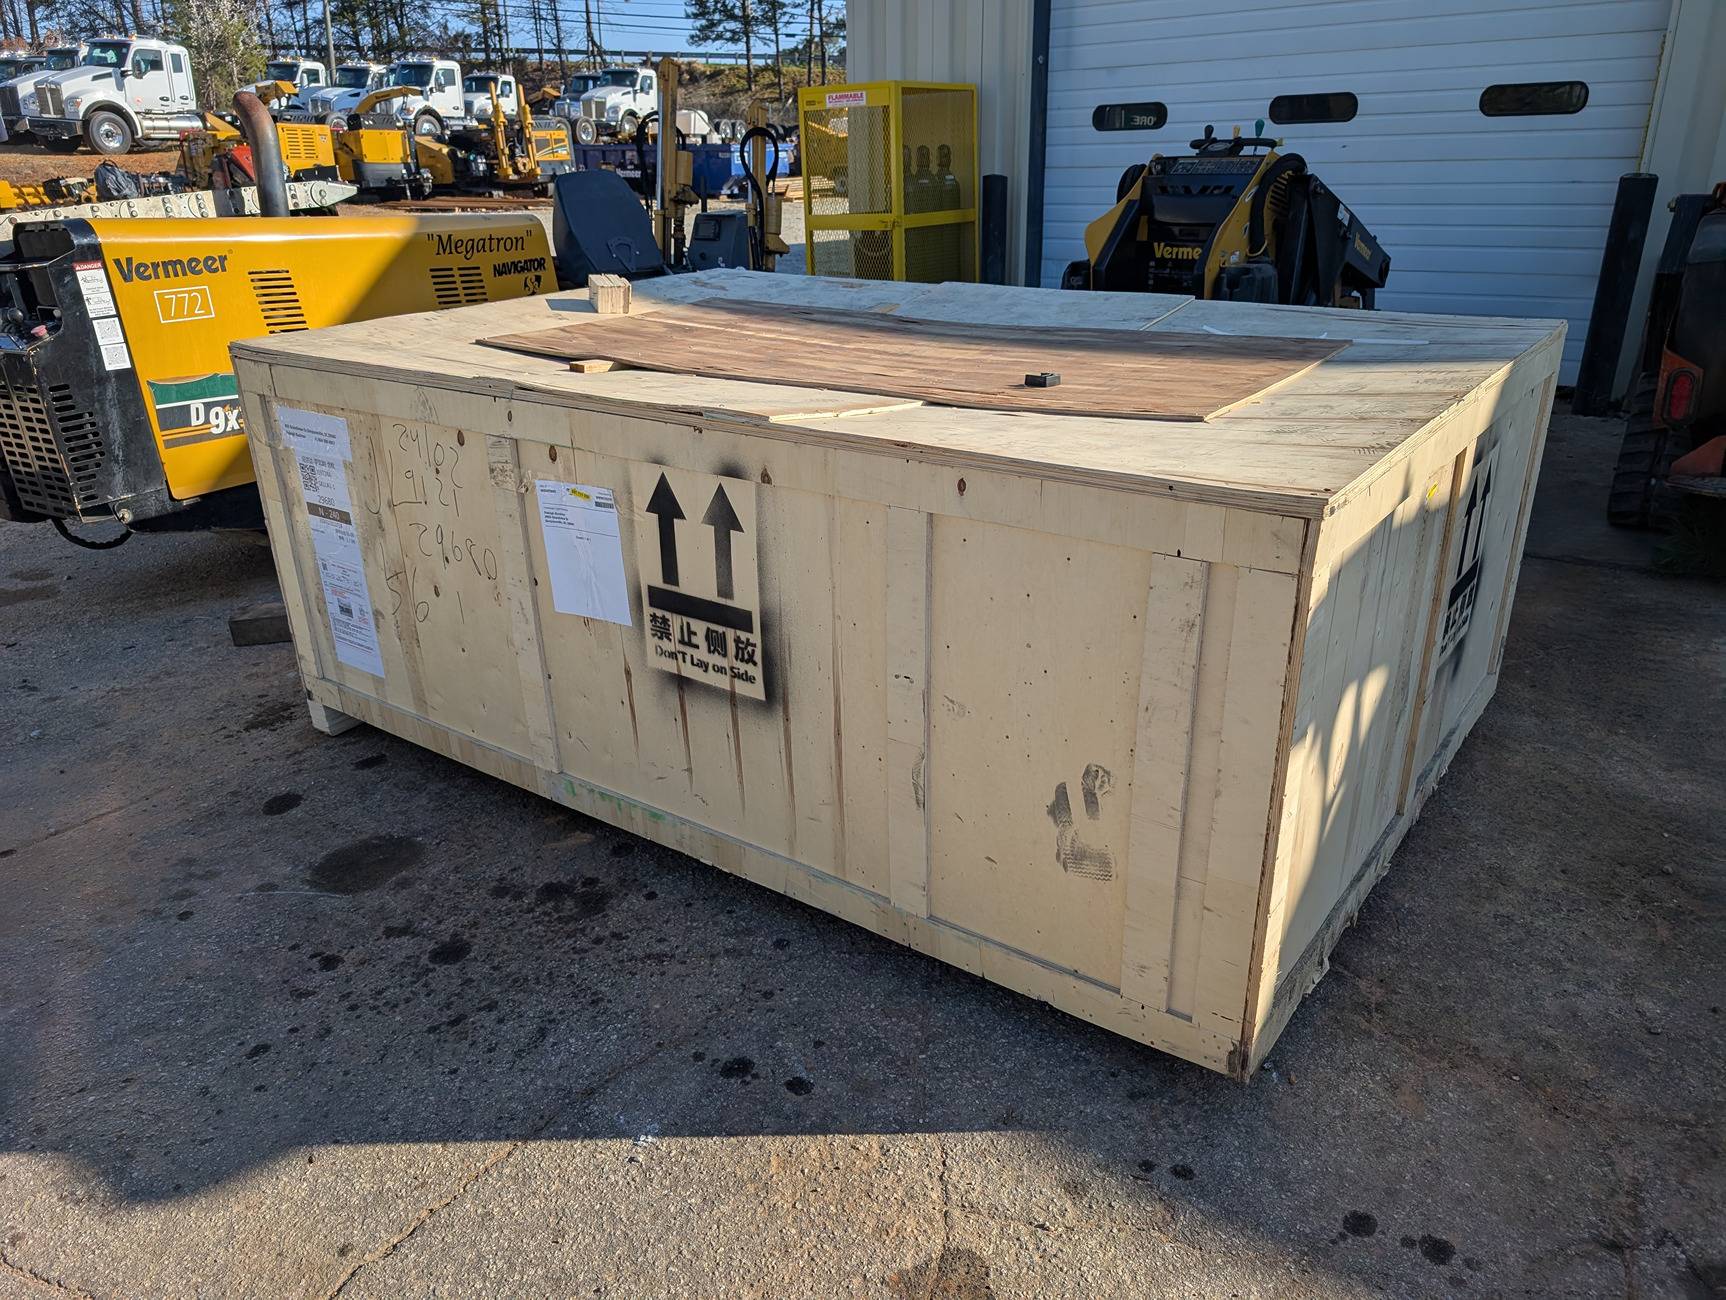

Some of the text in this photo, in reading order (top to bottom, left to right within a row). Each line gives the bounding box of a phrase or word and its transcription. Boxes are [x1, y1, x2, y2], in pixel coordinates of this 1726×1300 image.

[80, 262, 102, 271] DANGER
[113, 254, 228, 284] Vermeer
[493, 257, 547, 278] NAVIGATOR
[164, 292, 206, 318] 772
[649, 612, 758, 667] 禁止侧放
[690, 654, 710, 673] Lay
[712, 663, 728, 676] on
[729, 665, 757, 684] Side
